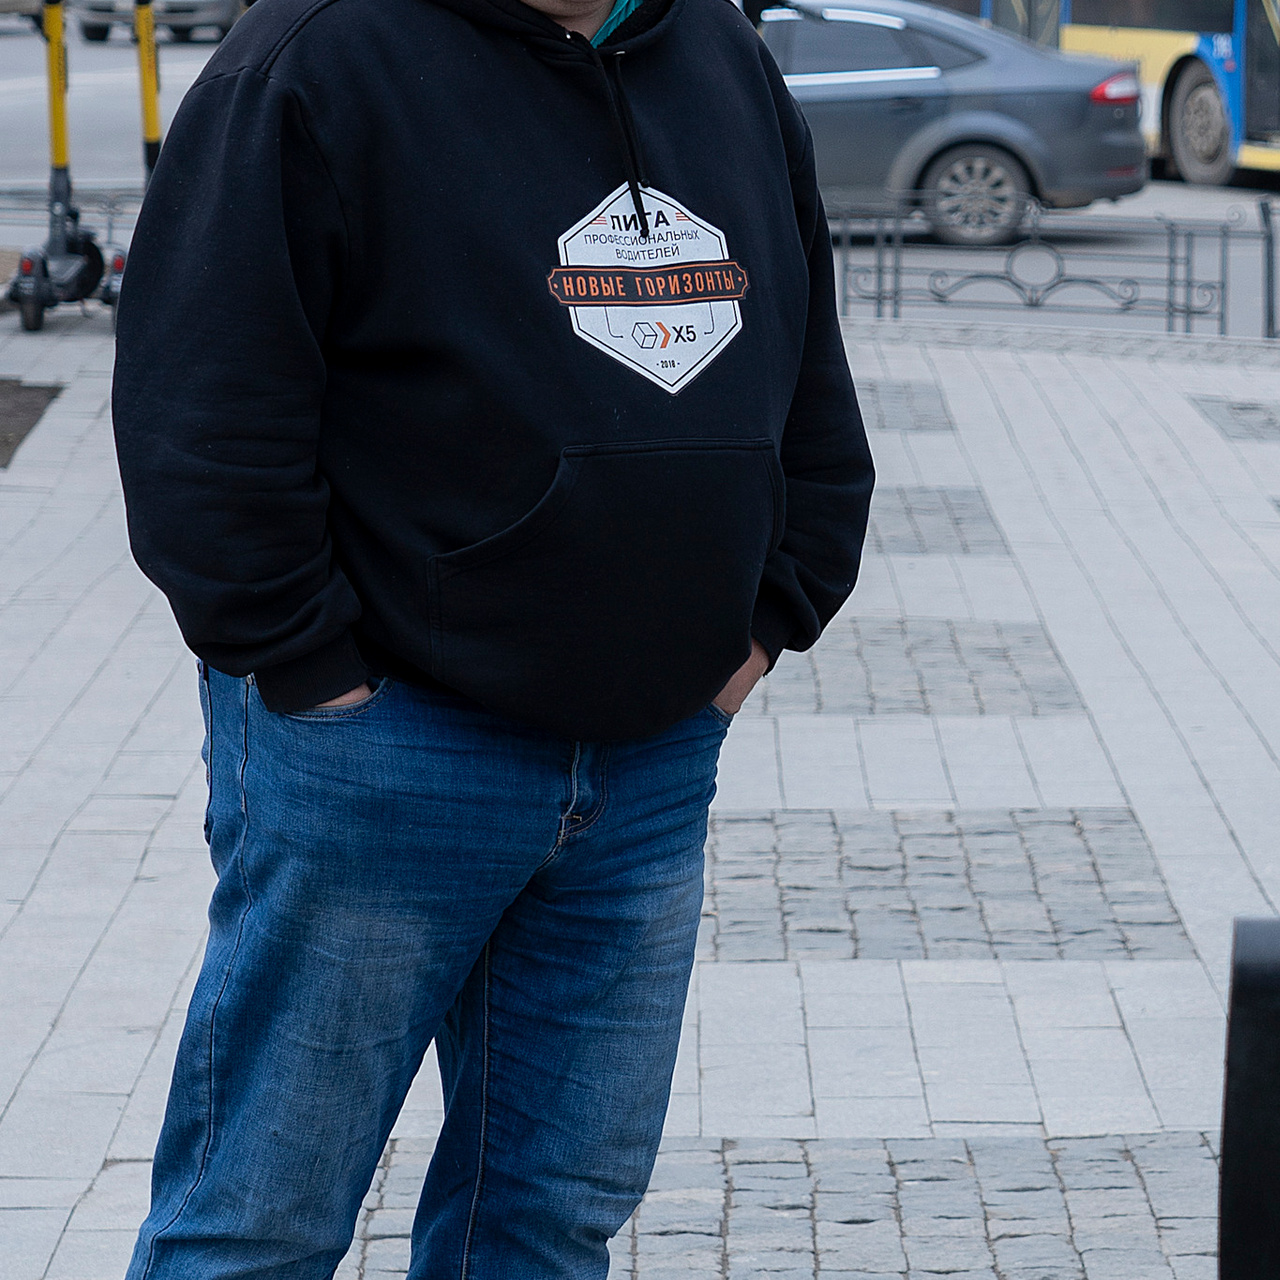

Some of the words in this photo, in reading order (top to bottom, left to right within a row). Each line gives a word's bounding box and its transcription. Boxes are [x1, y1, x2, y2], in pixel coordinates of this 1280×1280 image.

[584, 229, 700, 246] ПРОФЕССИОНАЛЬНЫХ
[615, 243, 680, 262] ВОДИТЕЛЕЙ
[562, 276, 627, 297] НОВЫЕ
[635, 270, 735, 296] ГОРИЗОНТЫ
